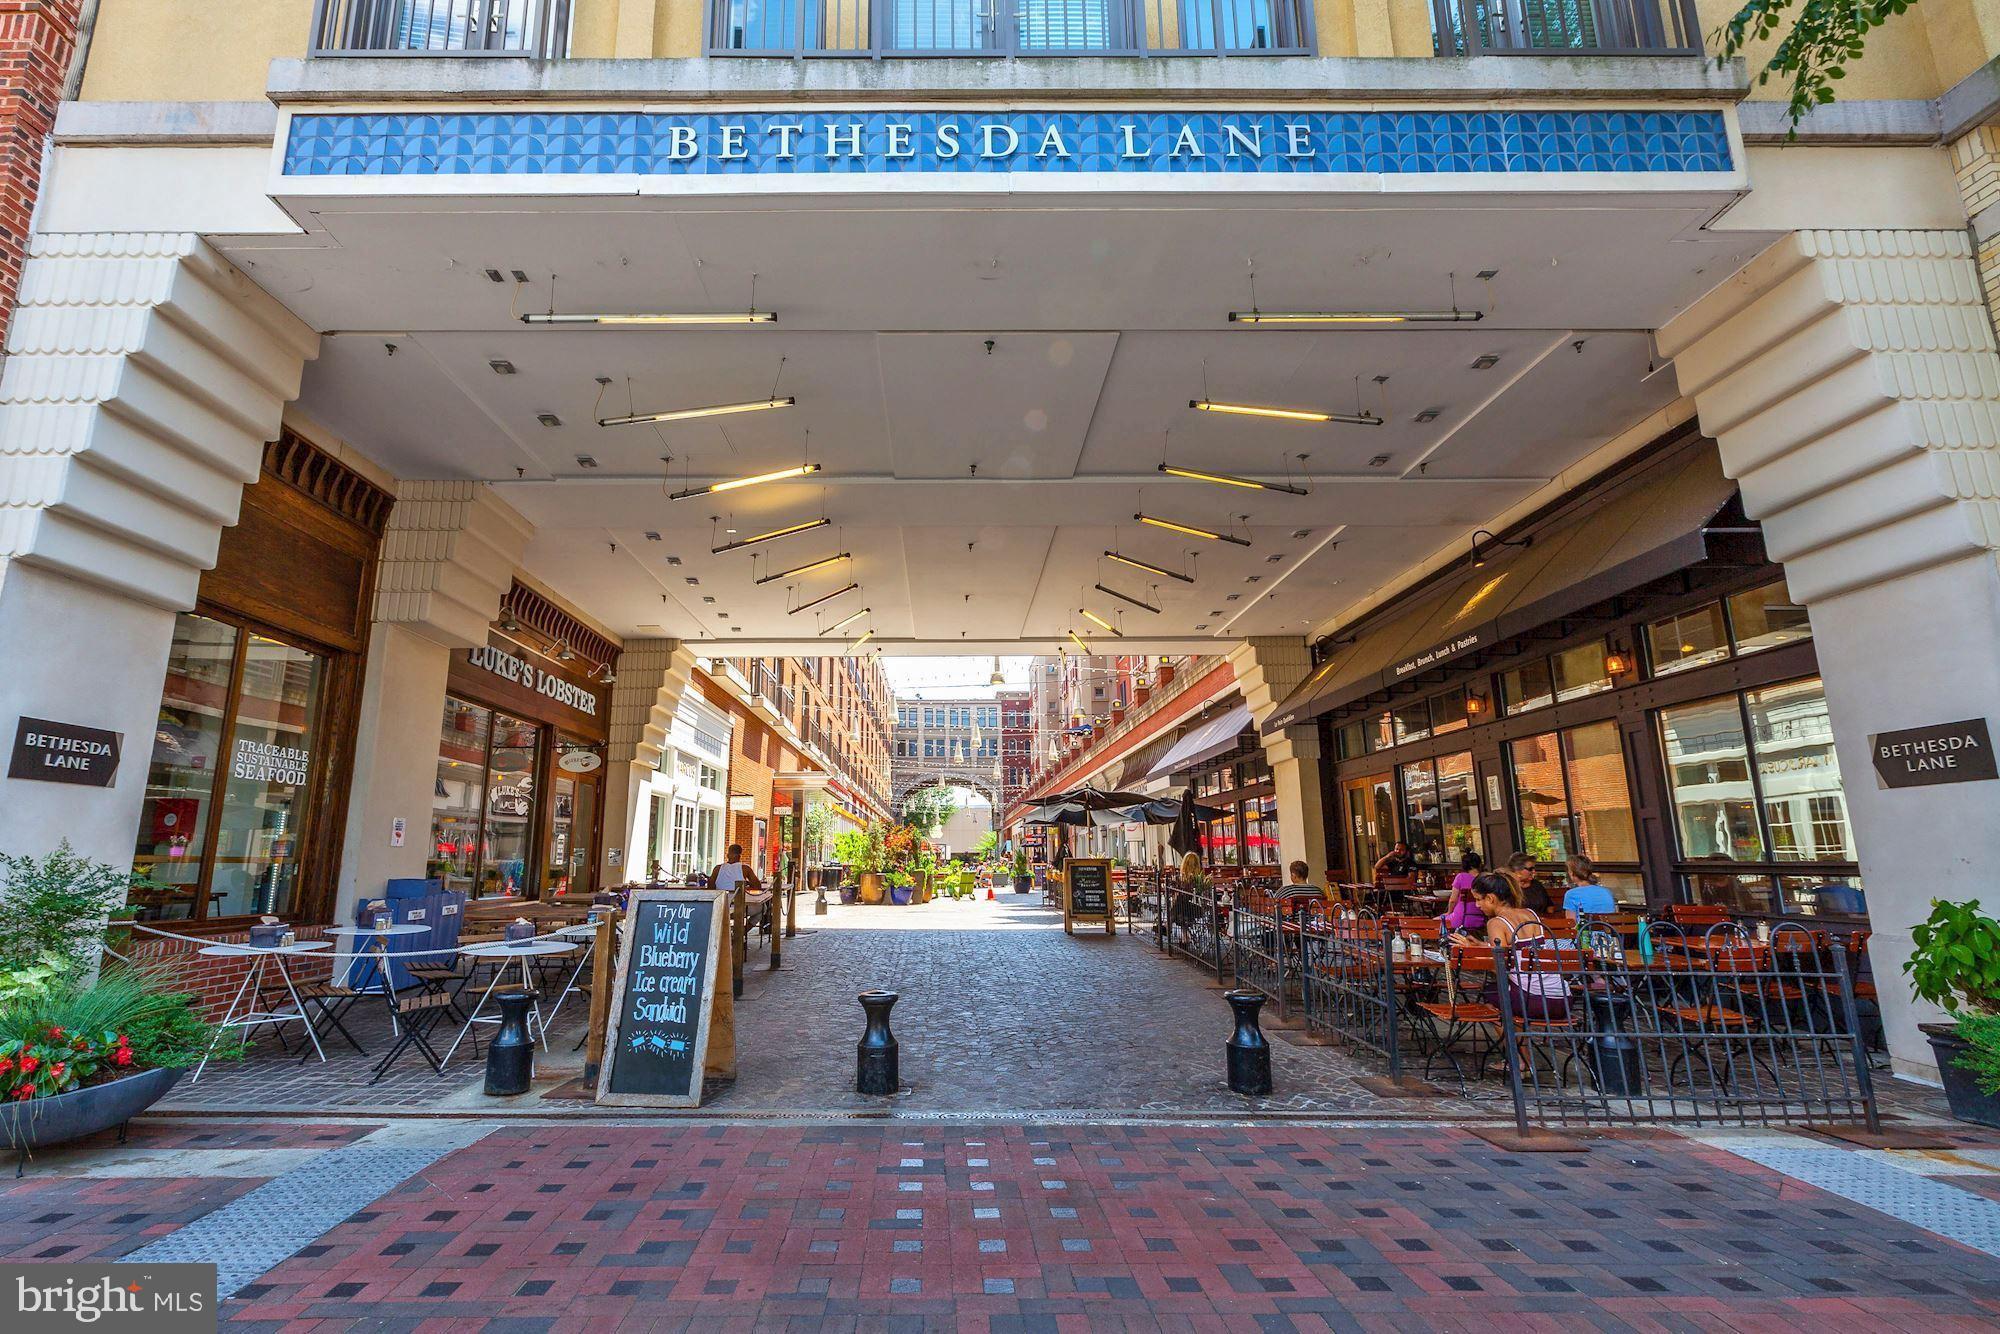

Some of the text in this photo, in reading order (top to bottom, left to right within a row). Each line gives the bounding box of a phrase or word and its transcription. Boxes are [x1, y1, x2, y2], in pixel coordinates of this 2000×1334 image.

[667, 124, 1318, 160] BETHESDA LANE
[1396, 635, 1478, 676] Breakfast, Brunch, Lunch & Pastries
[470, 645, 596, 716] LUKE'S LOBSTER
[25, 733, 112, 756] BETHESDA
[1880, 735, 1979, 759] BETHESDA
[44, 753, 91, 771] LANE
[236, 752, 308, 772] SUSTAINABLE
[1906, 755, 1957, 772] LANE
[656, 903, 695, 924] Try Our
[653, 922, 691, 945] Wild
[640, 944, 700, 977] Blueberry
[632, 970, 698, 995] Ice cream
[633, 996, 687, 1024] Sandwich
